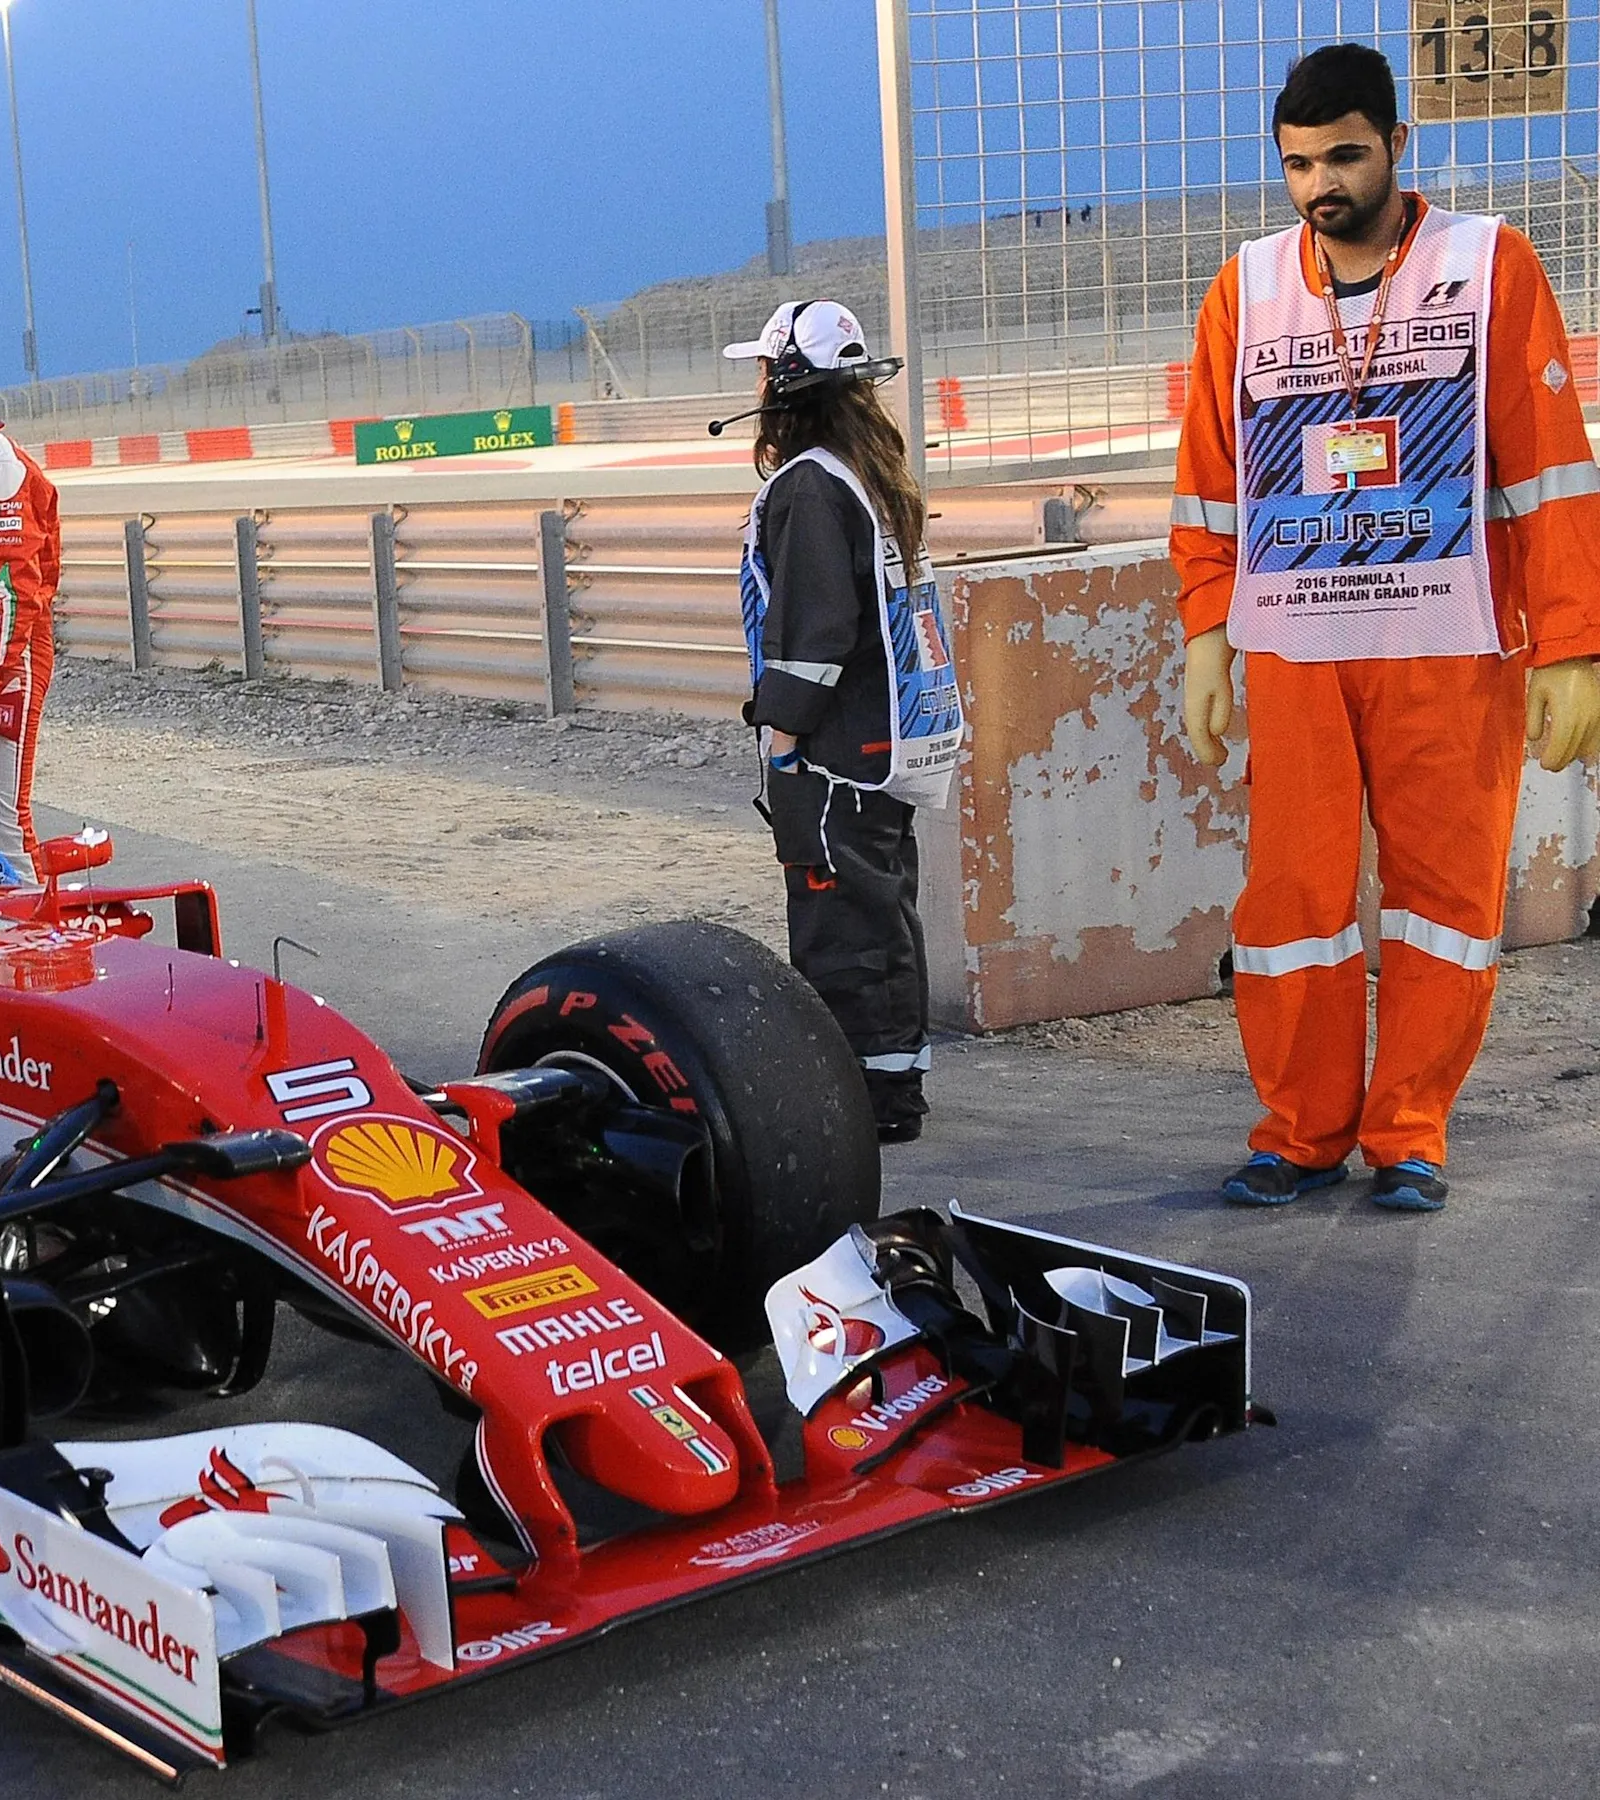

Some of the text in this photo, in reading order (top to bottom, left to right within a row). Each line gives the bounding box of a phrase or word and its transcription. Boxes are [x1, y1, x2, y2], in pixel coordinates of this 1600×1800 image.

[1421, 9, 1557, 85] 13.8
[1299, 322, 1470, 360] BH1121 2016
[1369, 358, 1428, 379] MARSHAL
[375, 442, 438, 461] ROLEX
[475, 432, 535, 451] ROLEX
[1274, 507, 1434, 548] COURSE
[1256, 582, 1452, 608] GULF AIR BAHRAIN GRAND PRIX
[1295, 571, 1406, 590] 2016 FORMULA 1
[266, 1058, 373, 1123] 5
[399, 1202, 509, 1247] TNT
[440, 1229, 514, 1252] ENERGY DRINK
[428, 1238, 554, 1285] KASPERSKY
[306, 1204, 467, 1378] KASPERSKY
[478, 1272, 582, 1312] PIRELLI
[494, 1297, 644, 1357] MAHLE
[545, 1331, 667, 1396] telcel
[850, 1373, 949, 1432] V-Power
[12, 1532, 200, 1686] Santander
